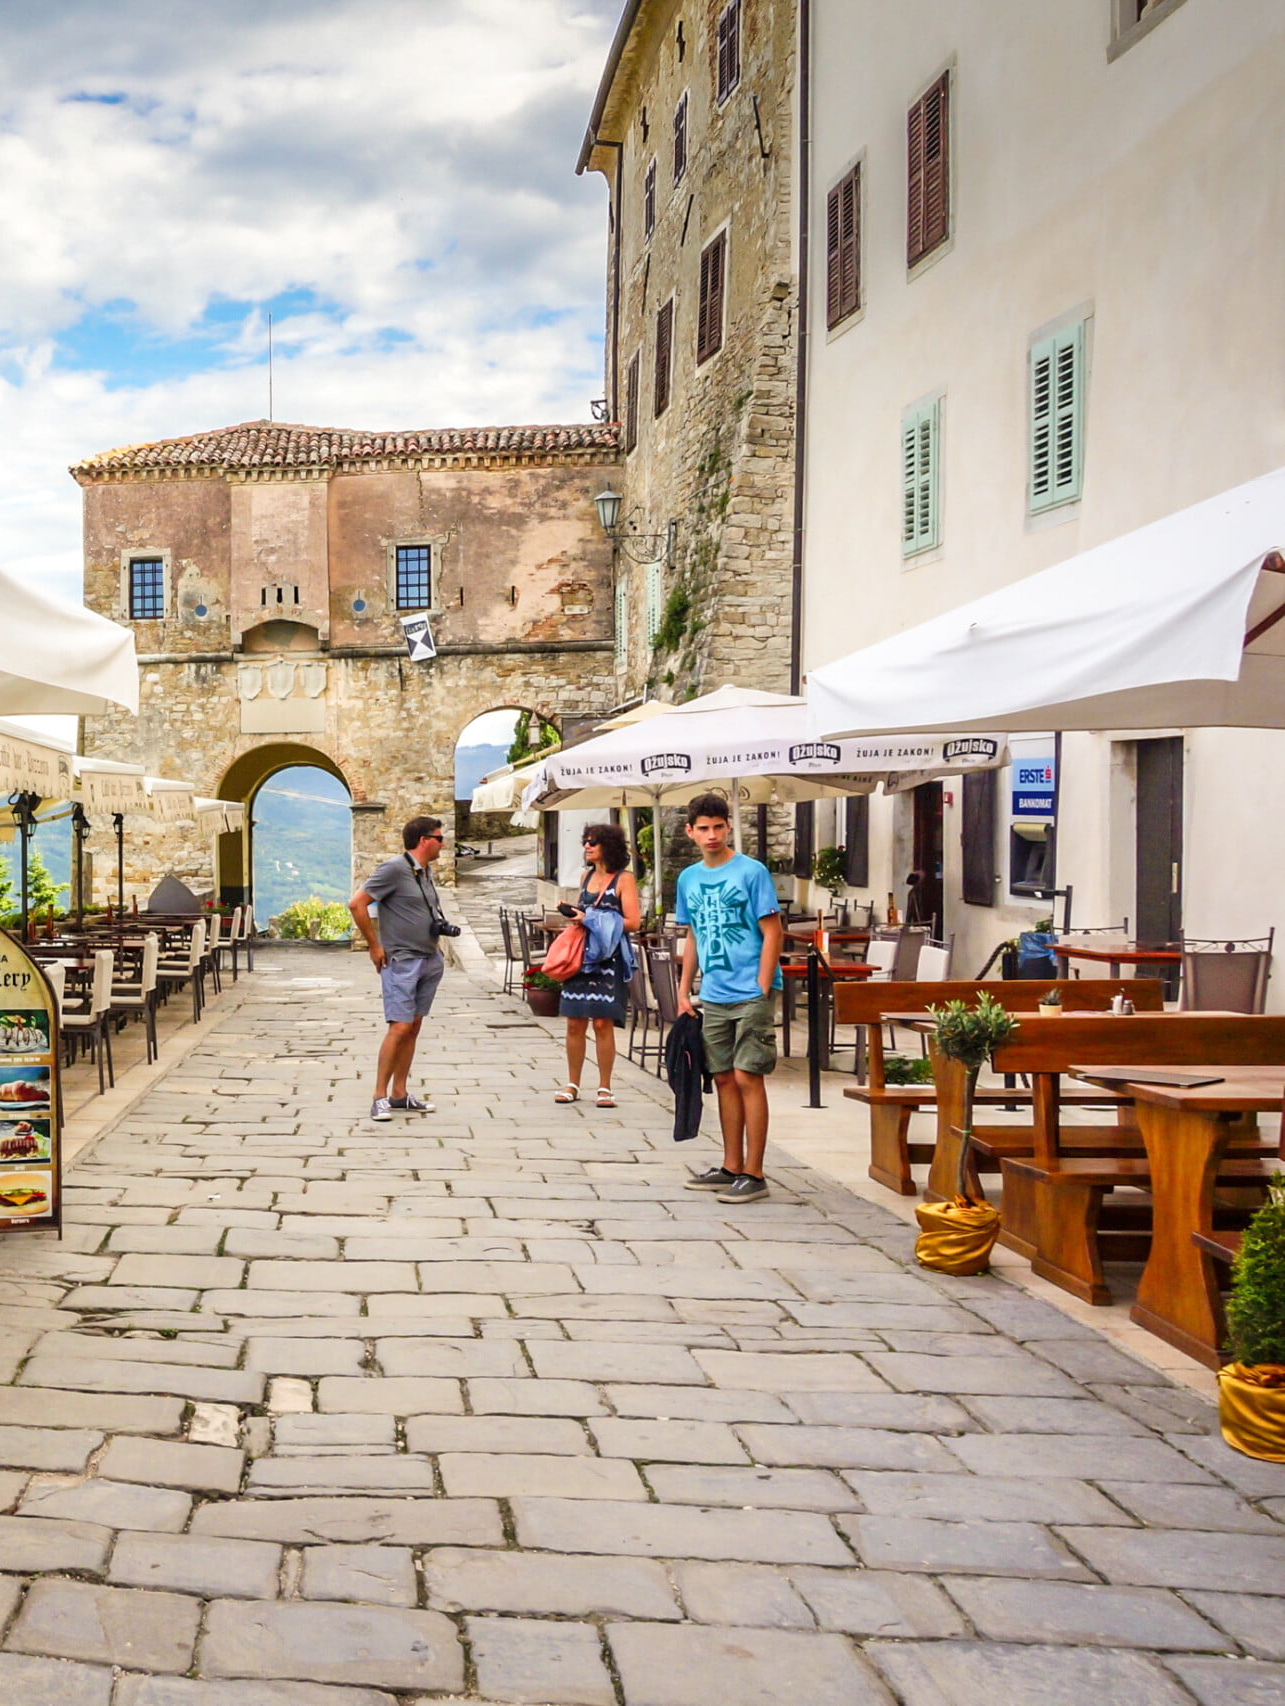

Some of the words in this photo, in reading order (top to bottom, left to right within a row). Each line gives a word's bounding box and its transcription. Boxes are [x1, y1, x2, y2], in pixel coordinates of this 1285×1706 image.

[792, 742, 839, 761] Ožujsko
[856, 747, 880, 758] ŽUJA
[883, 748, 893, 757] JE
[897, 747, 935, 757] ZAKON!
[946, 738, 995, 757] Ožujsko
[643, 753, 689, 772] Ožujsko
[706, 755, 729, 765] ŽUJA
[732, 754, 742, 763] JE
[746, 751, 781, 761] ZAKON!
[560, 766, 582, 776] ŽUJA
[586, 766, 595, 775] JE
[598, 764, 634, 774] ZAKON!
[1019, 768, 1045, 784] ERSTE
